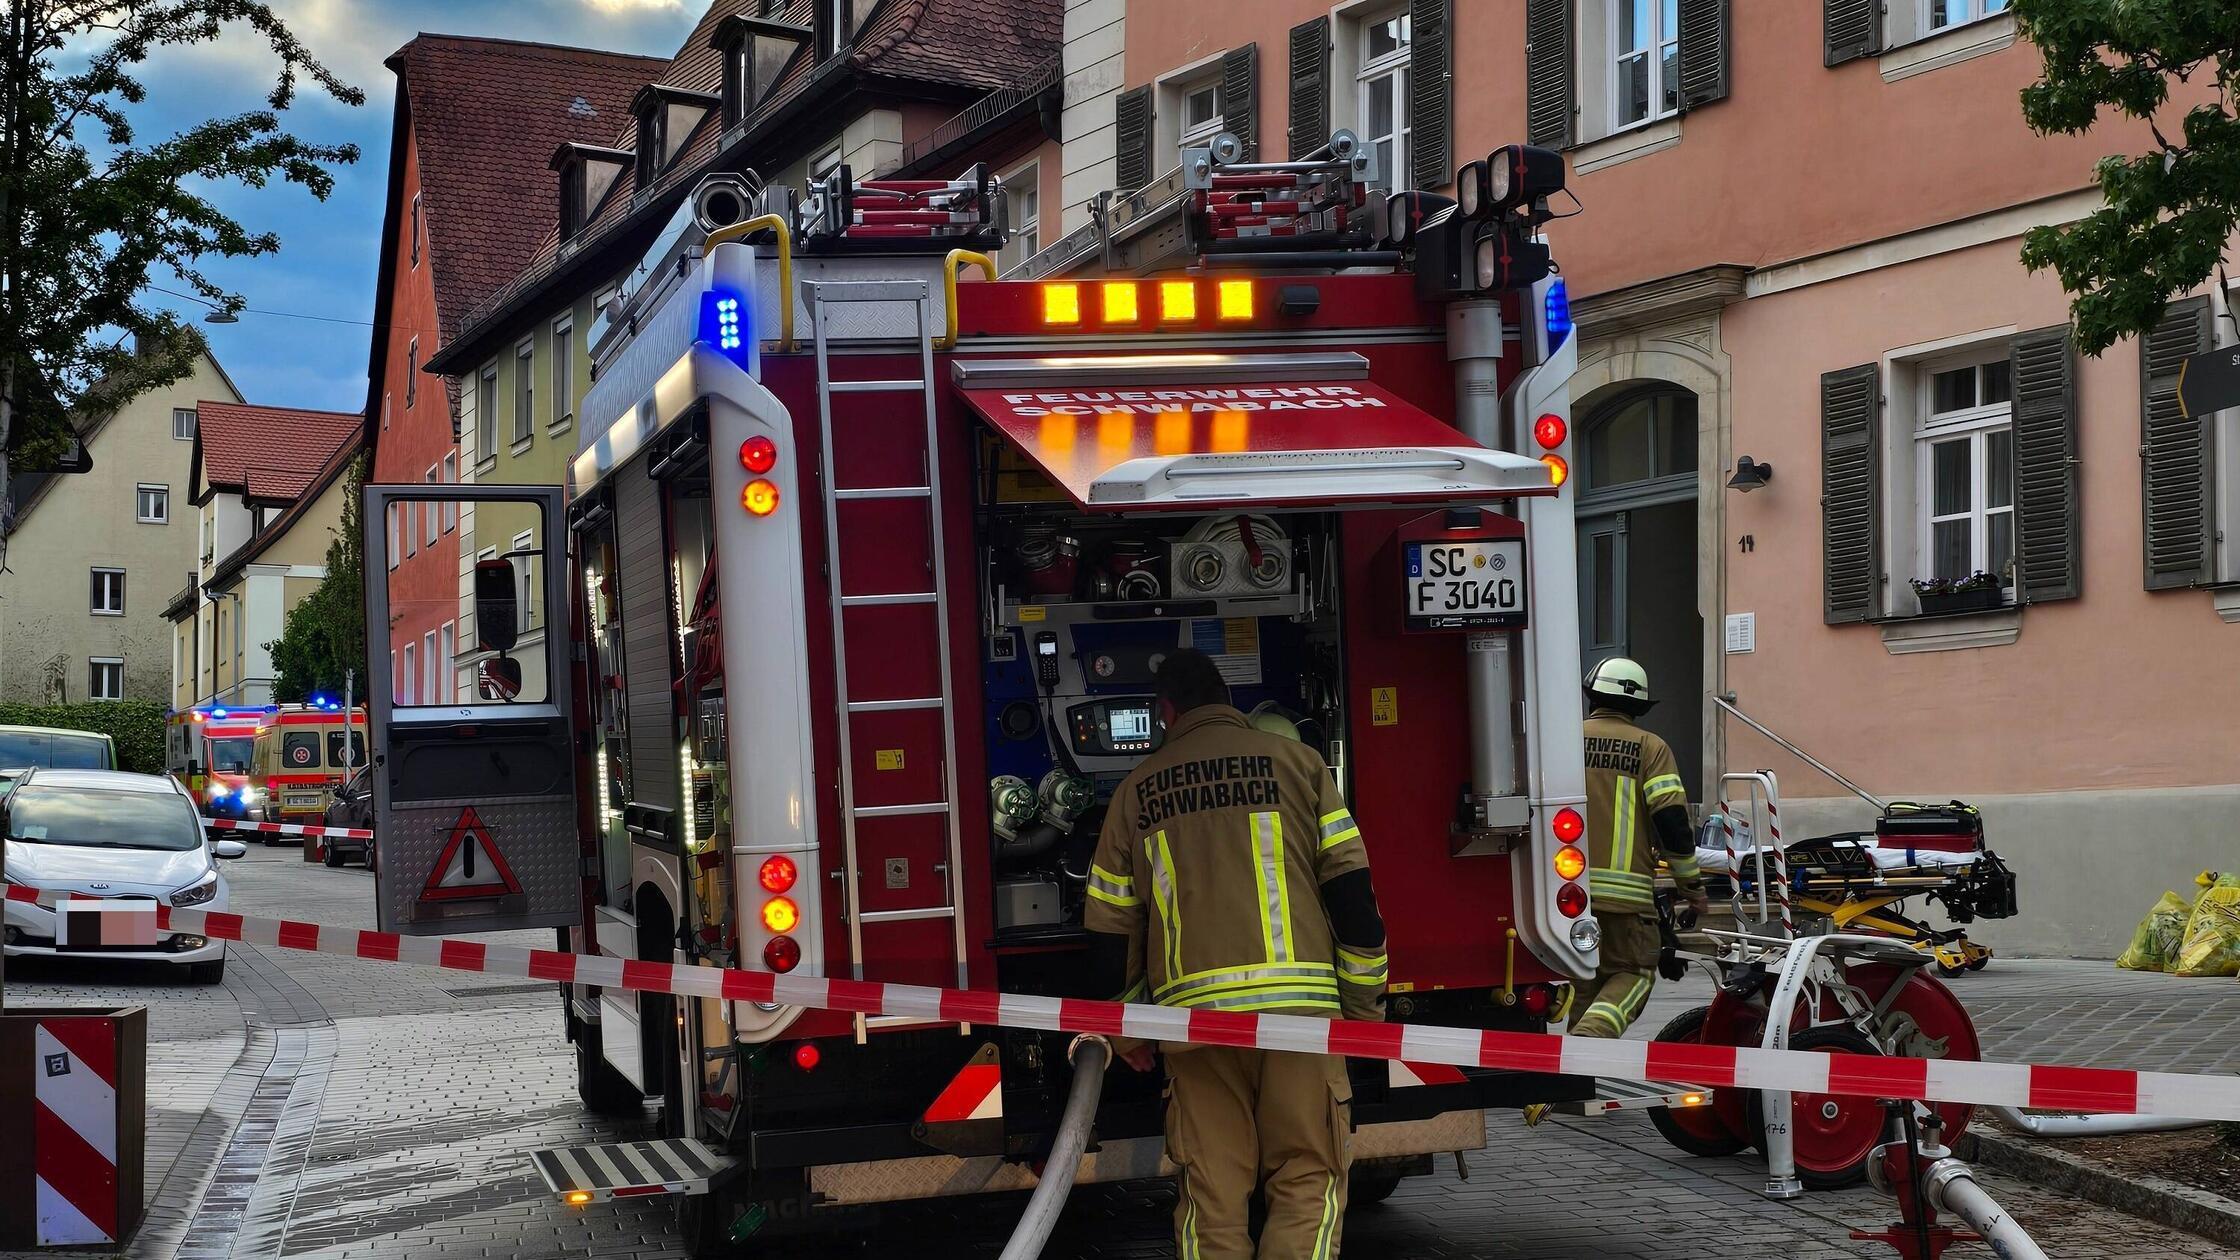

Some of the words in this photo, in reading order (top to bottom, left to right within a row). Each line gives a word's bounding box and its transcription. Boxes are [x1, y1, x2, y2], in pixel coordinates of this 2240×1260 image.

[1001, 386, 1361, 404] FEUERWEHR
[1012, 397, 1387, 416] SCHWABACH
[1738, 535, 1754, 553] 14
[1411, 564, 1418, 574] D
[1429, 548, 1466, 577] SC
[1418, 581, 1435, 611] F
[1444, 579, 1515, 610] 3040
[1136, 755, 1273, 805] FEUERWEHR
[1137, 780, 1280, 830] SCHWABACH
[1765, 1123, 1787, 1134] 176
